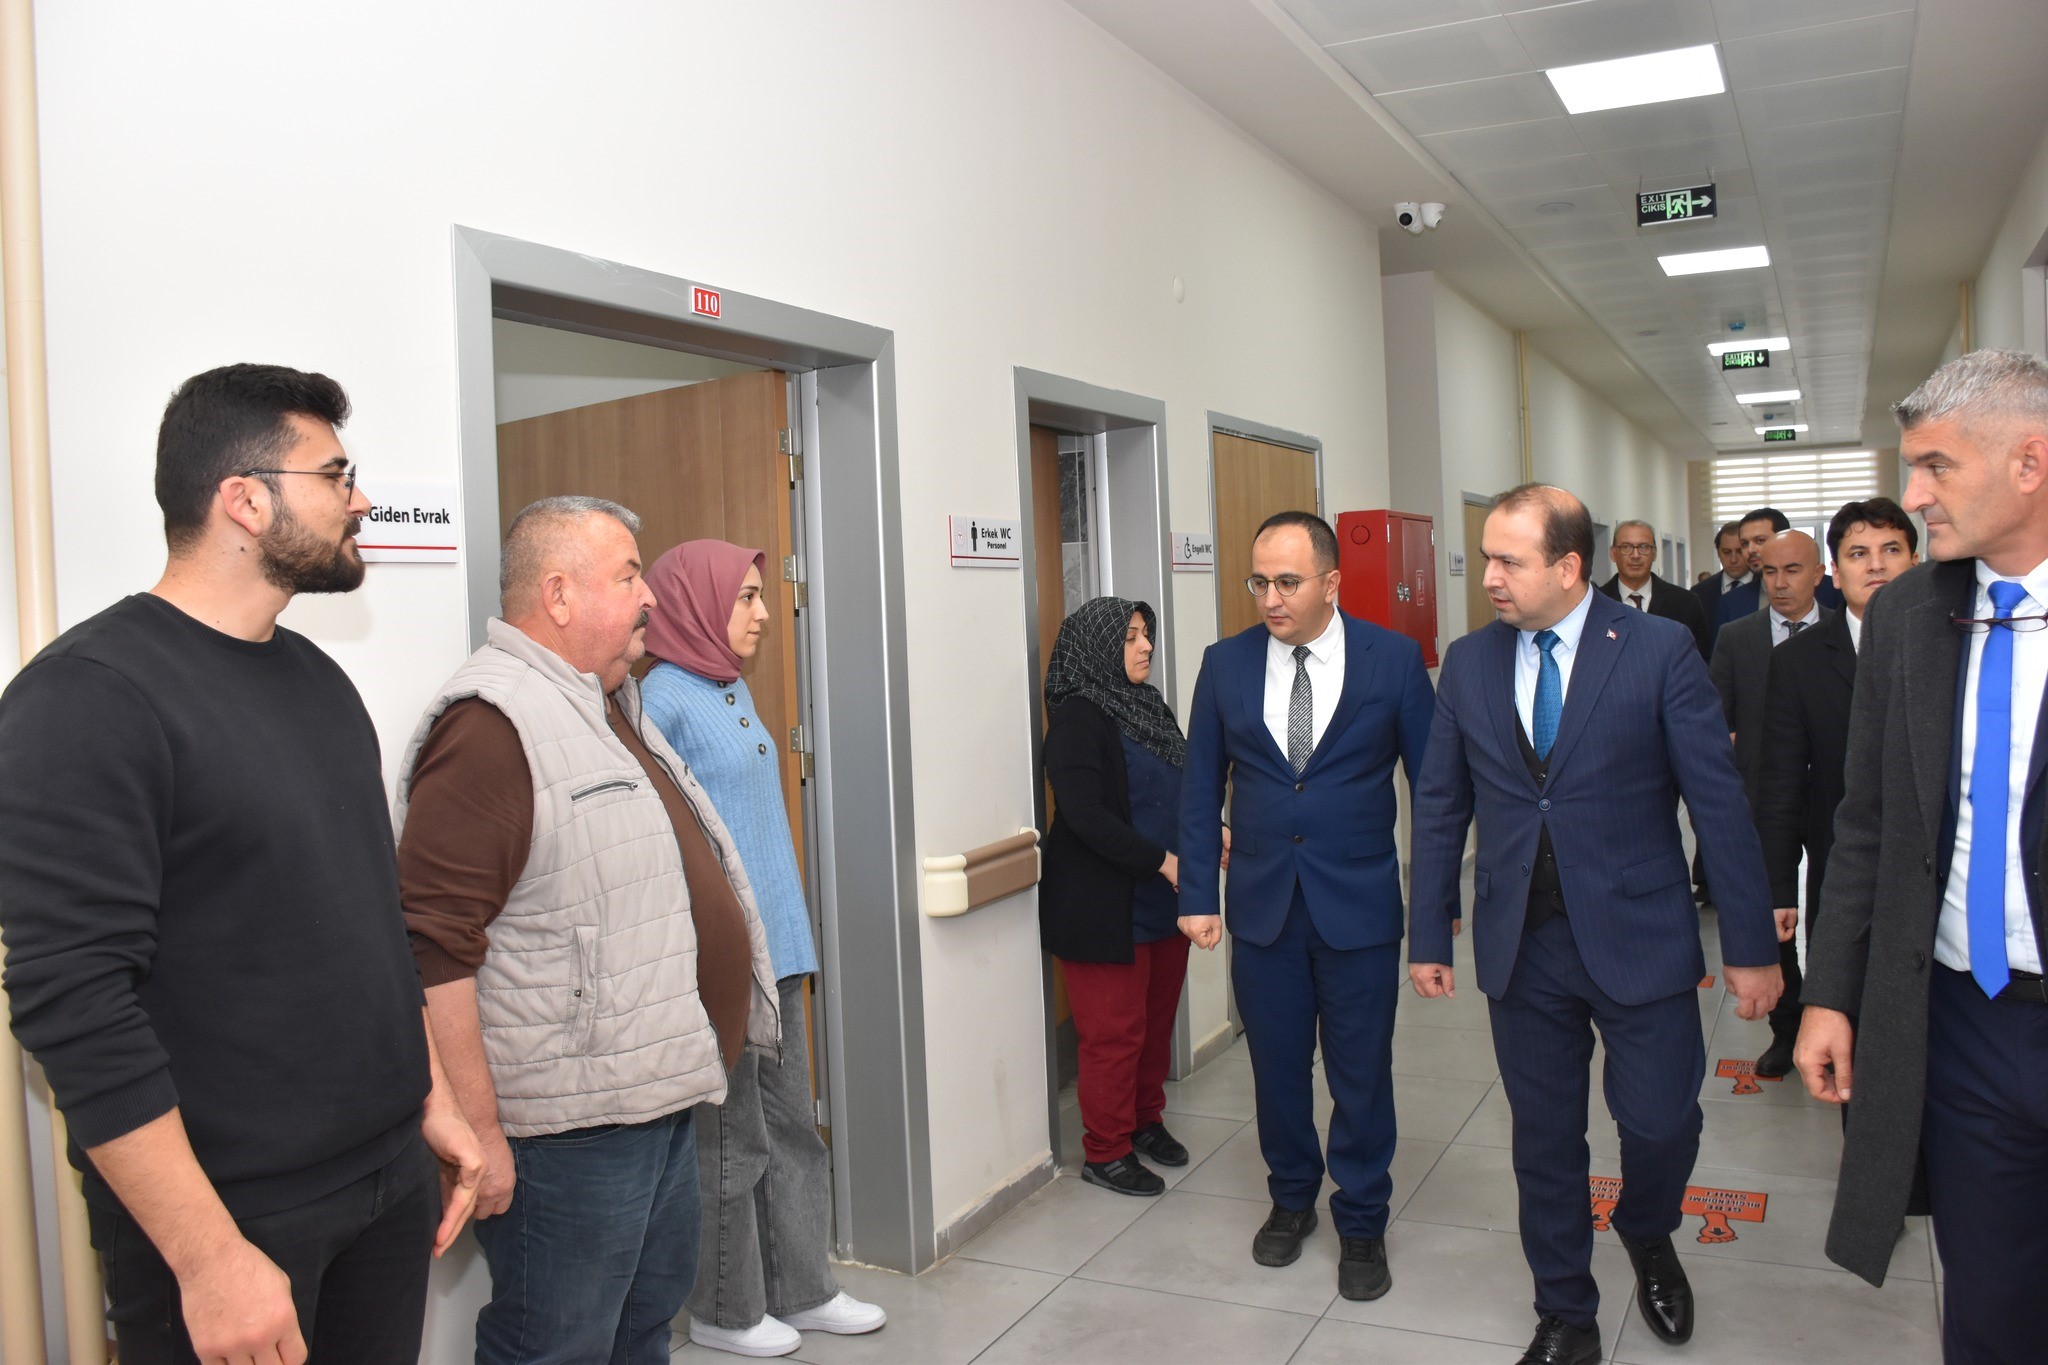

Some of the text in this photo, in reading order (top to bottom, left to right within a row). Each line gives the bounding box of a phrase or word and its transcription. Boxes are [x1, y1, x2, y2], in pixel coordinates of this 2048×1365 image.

[1641, 194, 1666, 204] EXIT
[696, 292, 718, 313] 110
[413, 508, 450, 524] Evrak
[981, 527, 1012, 540] Erkek WC
[987, 541, 1007, 550] Personel
[1192, 544, 1212, 555] Engelli WC
